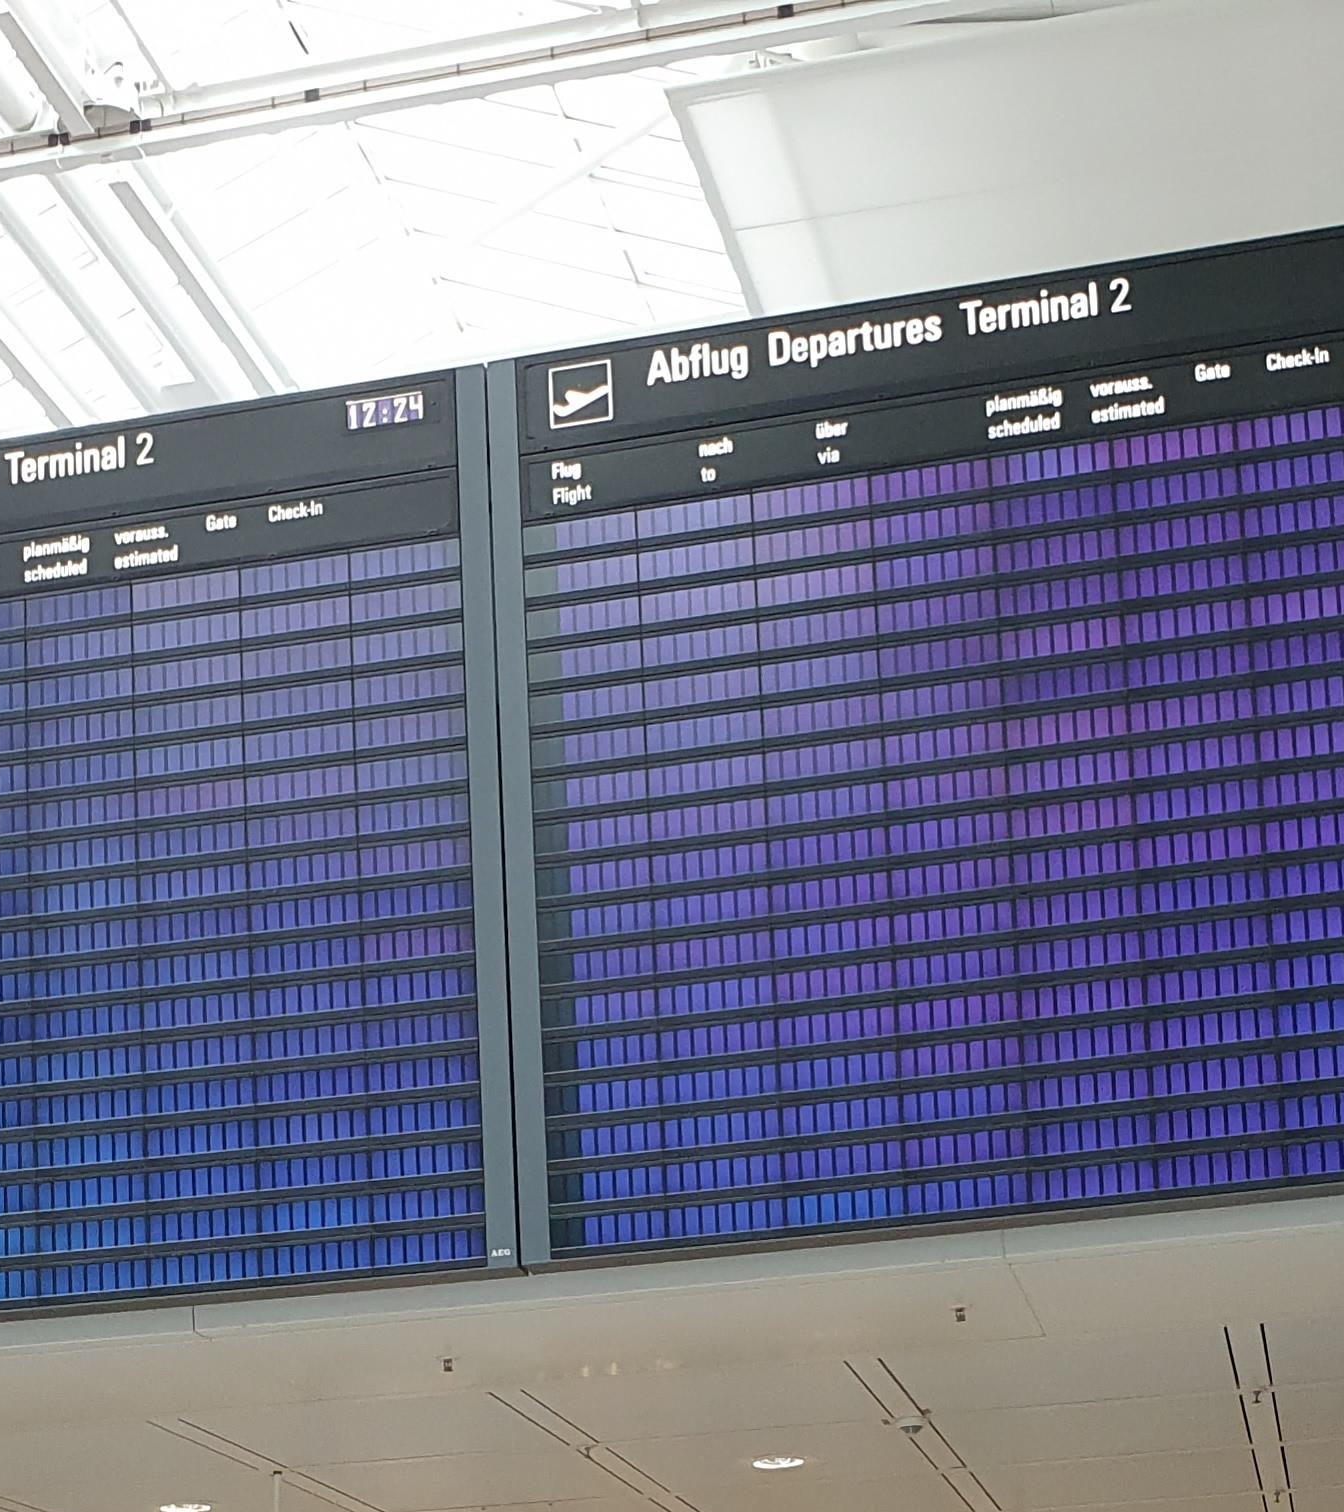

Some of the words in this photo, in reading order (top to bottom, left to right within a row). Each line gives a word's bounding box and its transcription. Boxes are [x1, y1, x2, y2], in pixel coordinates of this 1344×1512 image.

[647, 343, 748, 385] Abflug
[768, 316, 942, 367] Departures
[959, 281, 1098, 335] Terminal
[1109, 277, 1132, 313] 2
[348, 394, 423, 430] 12:24
[1092, 396, 1164, 423] estimated
[816, 421, 848, 439] über
[988, 412, 1060, 439] scheduled
[4, 436, 125, 484] Terminal
[136, 432, 154, 465] 2
[699, 437, 733, 457] nach
[818, 447, 839, 464] via
[552, 462, 581, 479] Flug
[701, 468, 716, 482] to
[553, 485, 591, 505] Flight
[114, 544, 178, 569] estimated
[24, 558, 87, 582] scheduled
[491, 1248, 511, 1257] AEG
